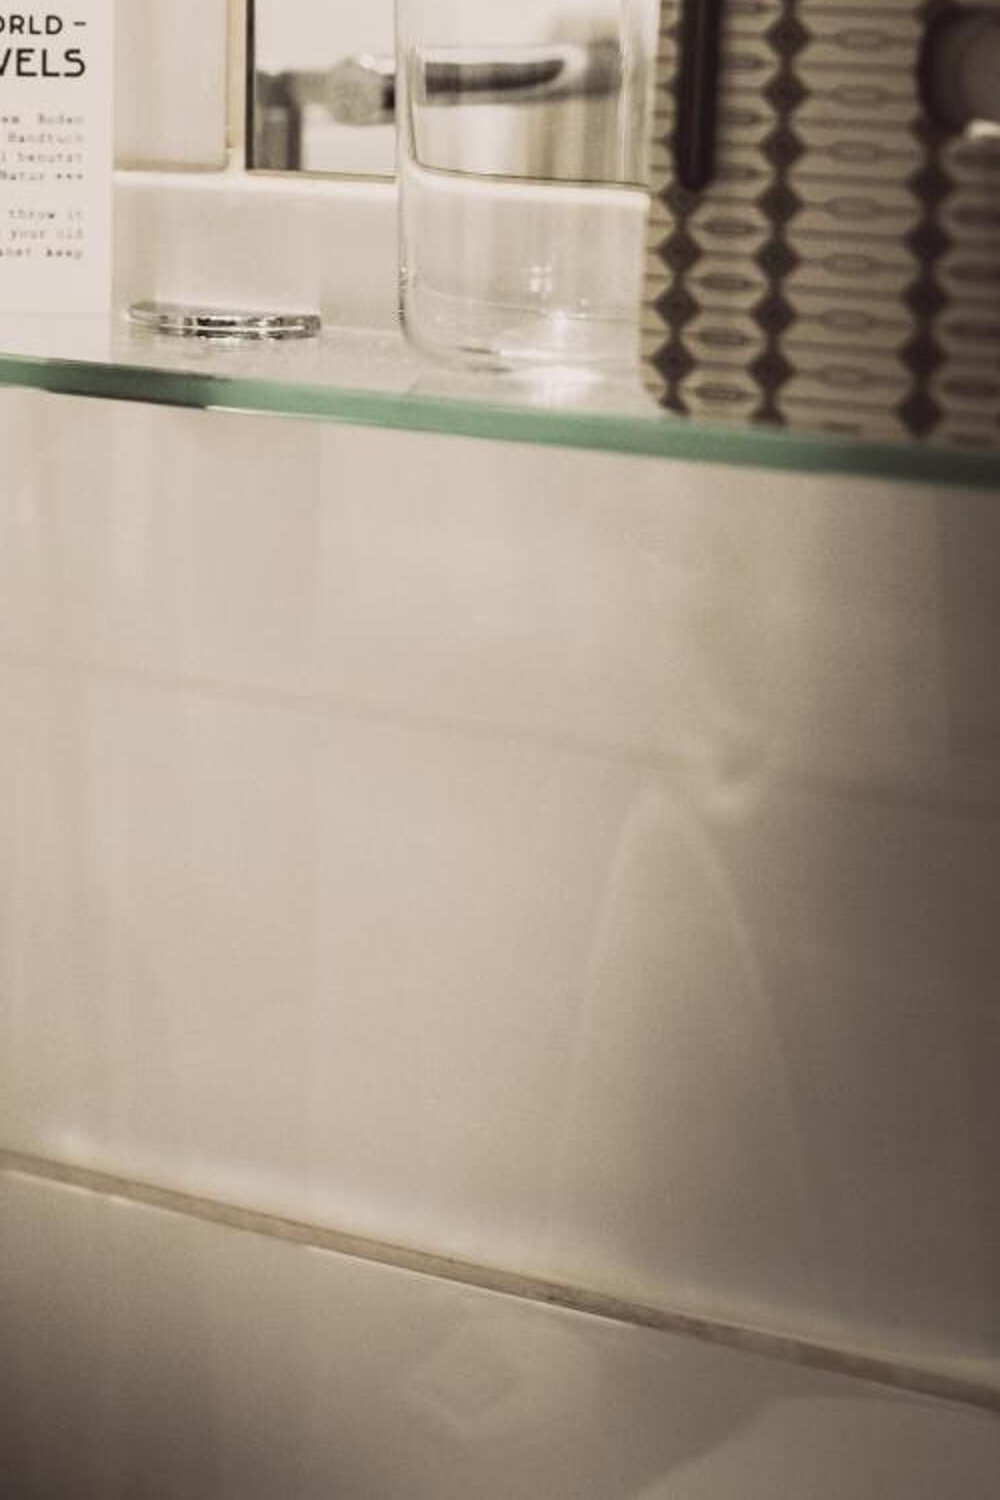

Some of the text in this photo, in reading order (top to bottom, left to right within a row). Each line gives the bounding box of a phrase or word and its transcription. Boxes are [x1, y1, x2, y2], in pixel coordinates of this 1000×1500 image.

[7, 131, 85, 144] Handtuch
[10, 228, 46, 241] your
[45, 247, 83, 260] keep
